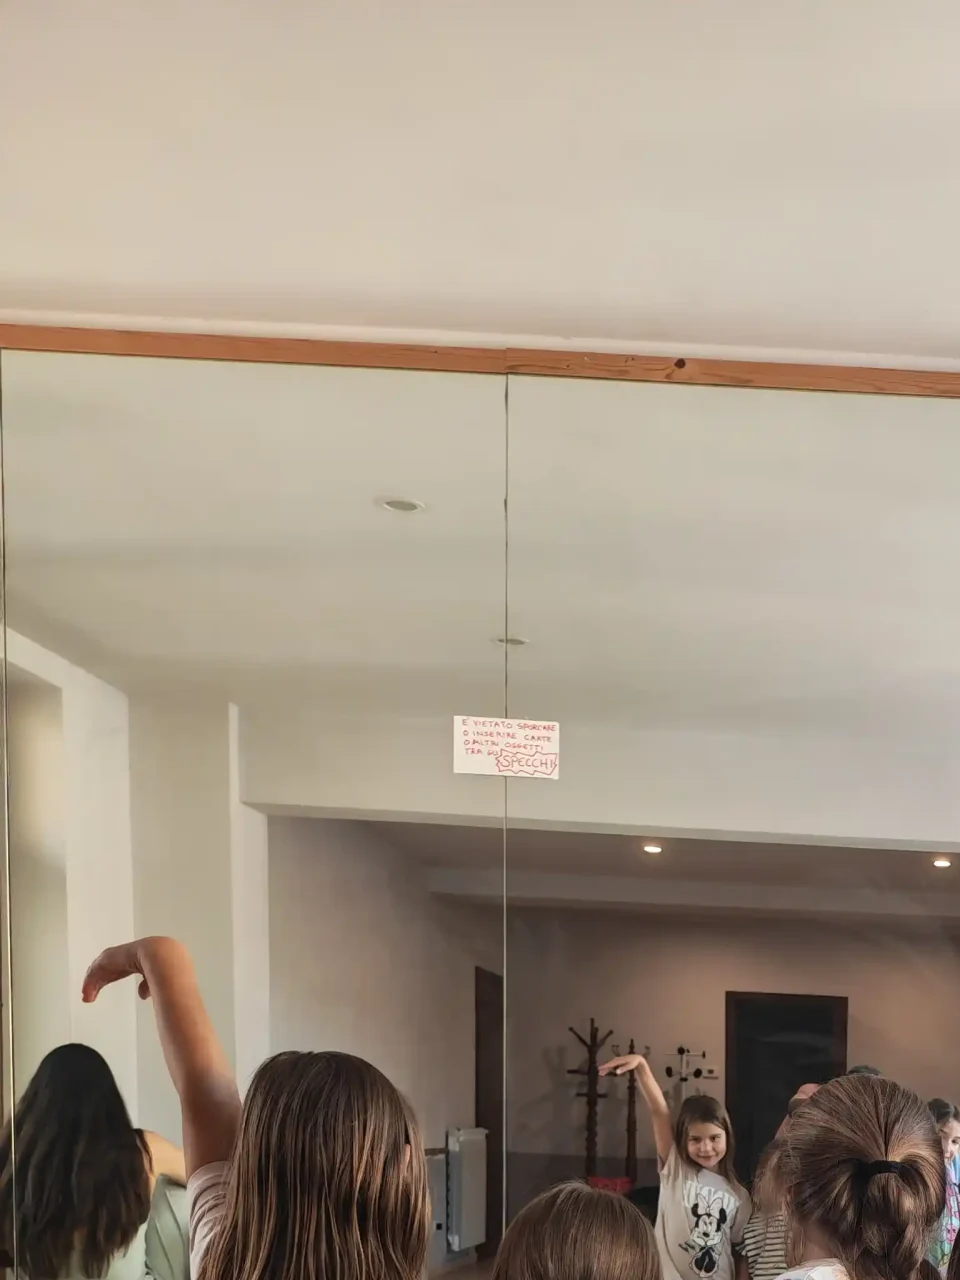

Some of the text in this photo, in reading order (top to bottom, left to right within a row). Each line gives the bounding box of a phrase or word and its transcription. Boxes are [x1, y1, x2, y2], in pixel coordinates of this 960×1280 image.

[473, 720, 513, 729] VIETATO
[516, 722, 557, 732] SPORCARE
[472, 730, 518, 739] INSERIRE
[523, 734, 552, 743] CARTE
[464, 747, 483, 755] TRA
[504, 741, 544, 751] OGGETTI
[500, 754, 553, 770] SPECCHI
